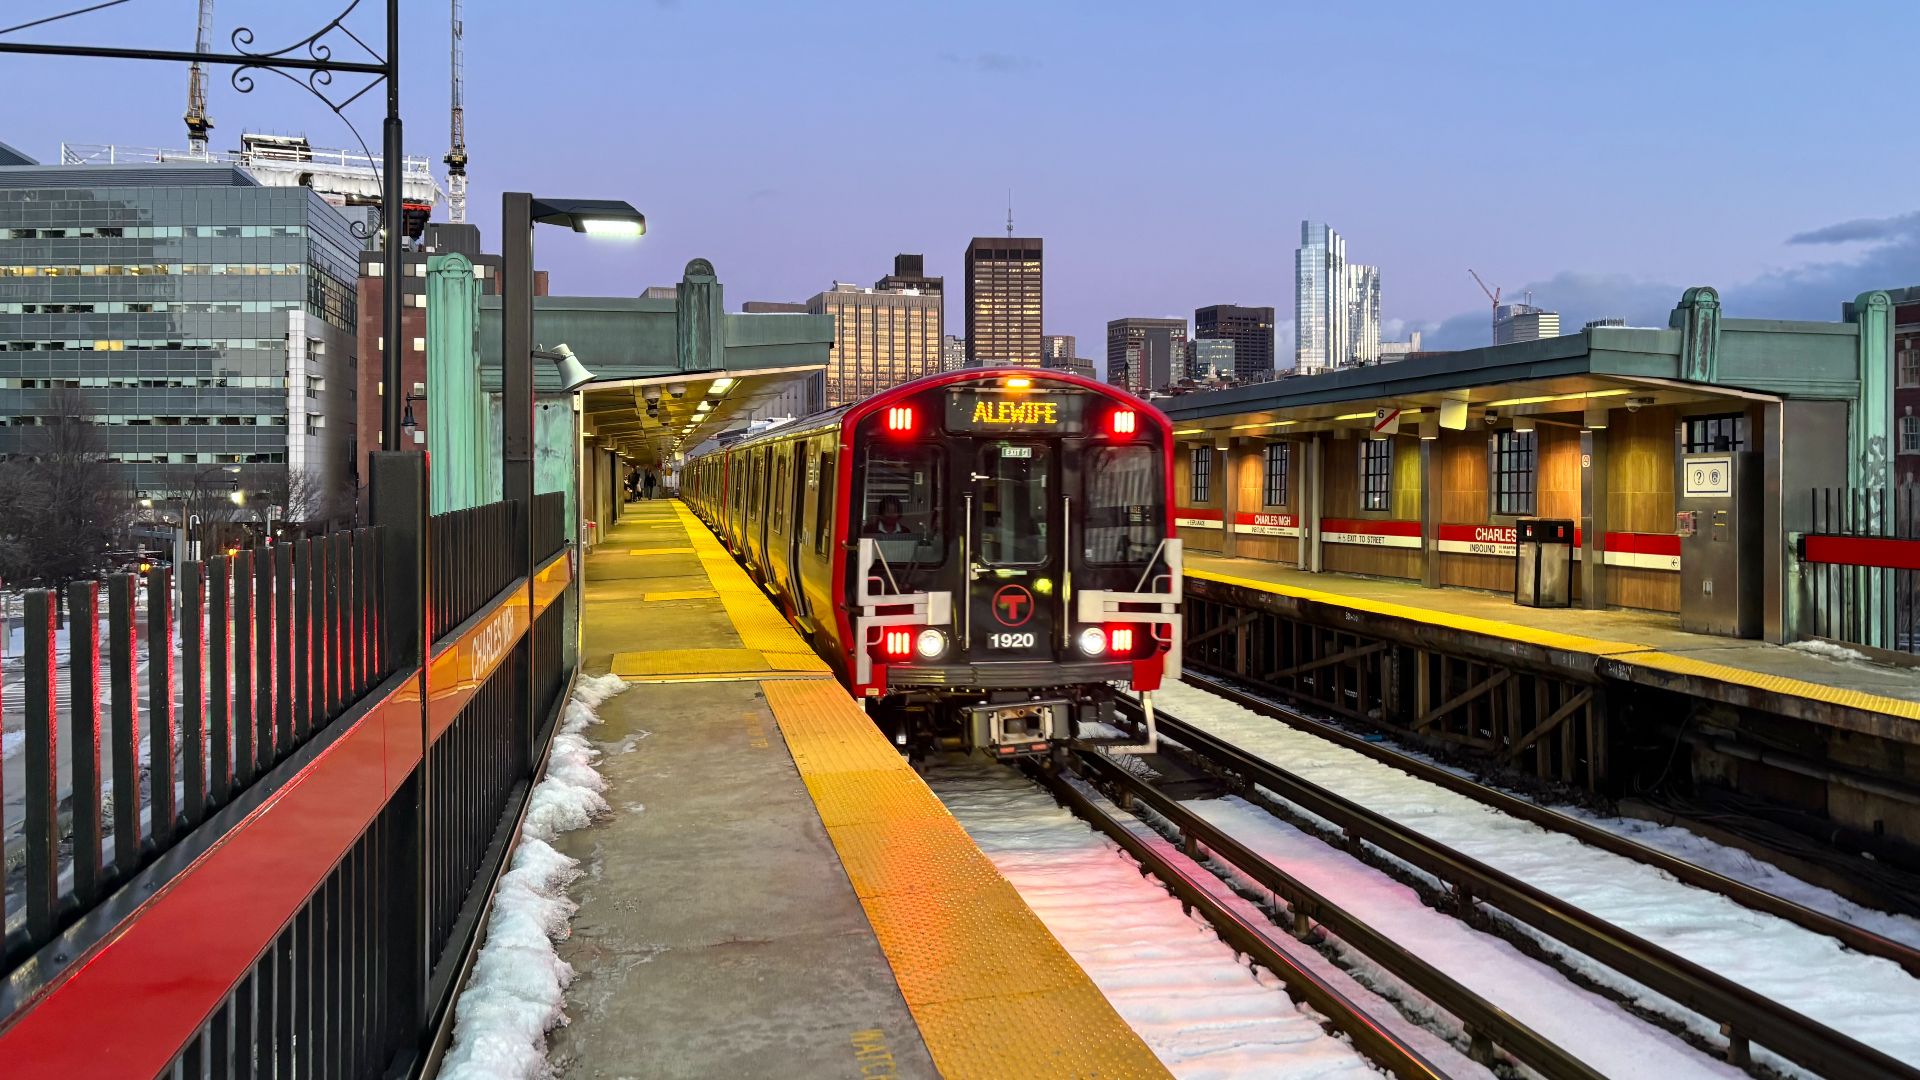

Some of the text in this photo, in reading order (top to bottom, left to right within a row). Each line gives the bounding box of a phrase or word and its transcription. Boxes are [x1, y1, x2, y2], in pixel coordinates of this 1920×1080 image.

[972, 401, 1058, 424] ALEWIFE
[1377, 409, 1385, 419] 6
[1347, 534, 1385, 544] EXIT TO STREET
[1475, 527, 1517, 542] CHARLES
[1469, 543, 1496, 553] INBOUND
[1000, 595, 1027, 619] T
[990, 633, 1034, 648] 1920
